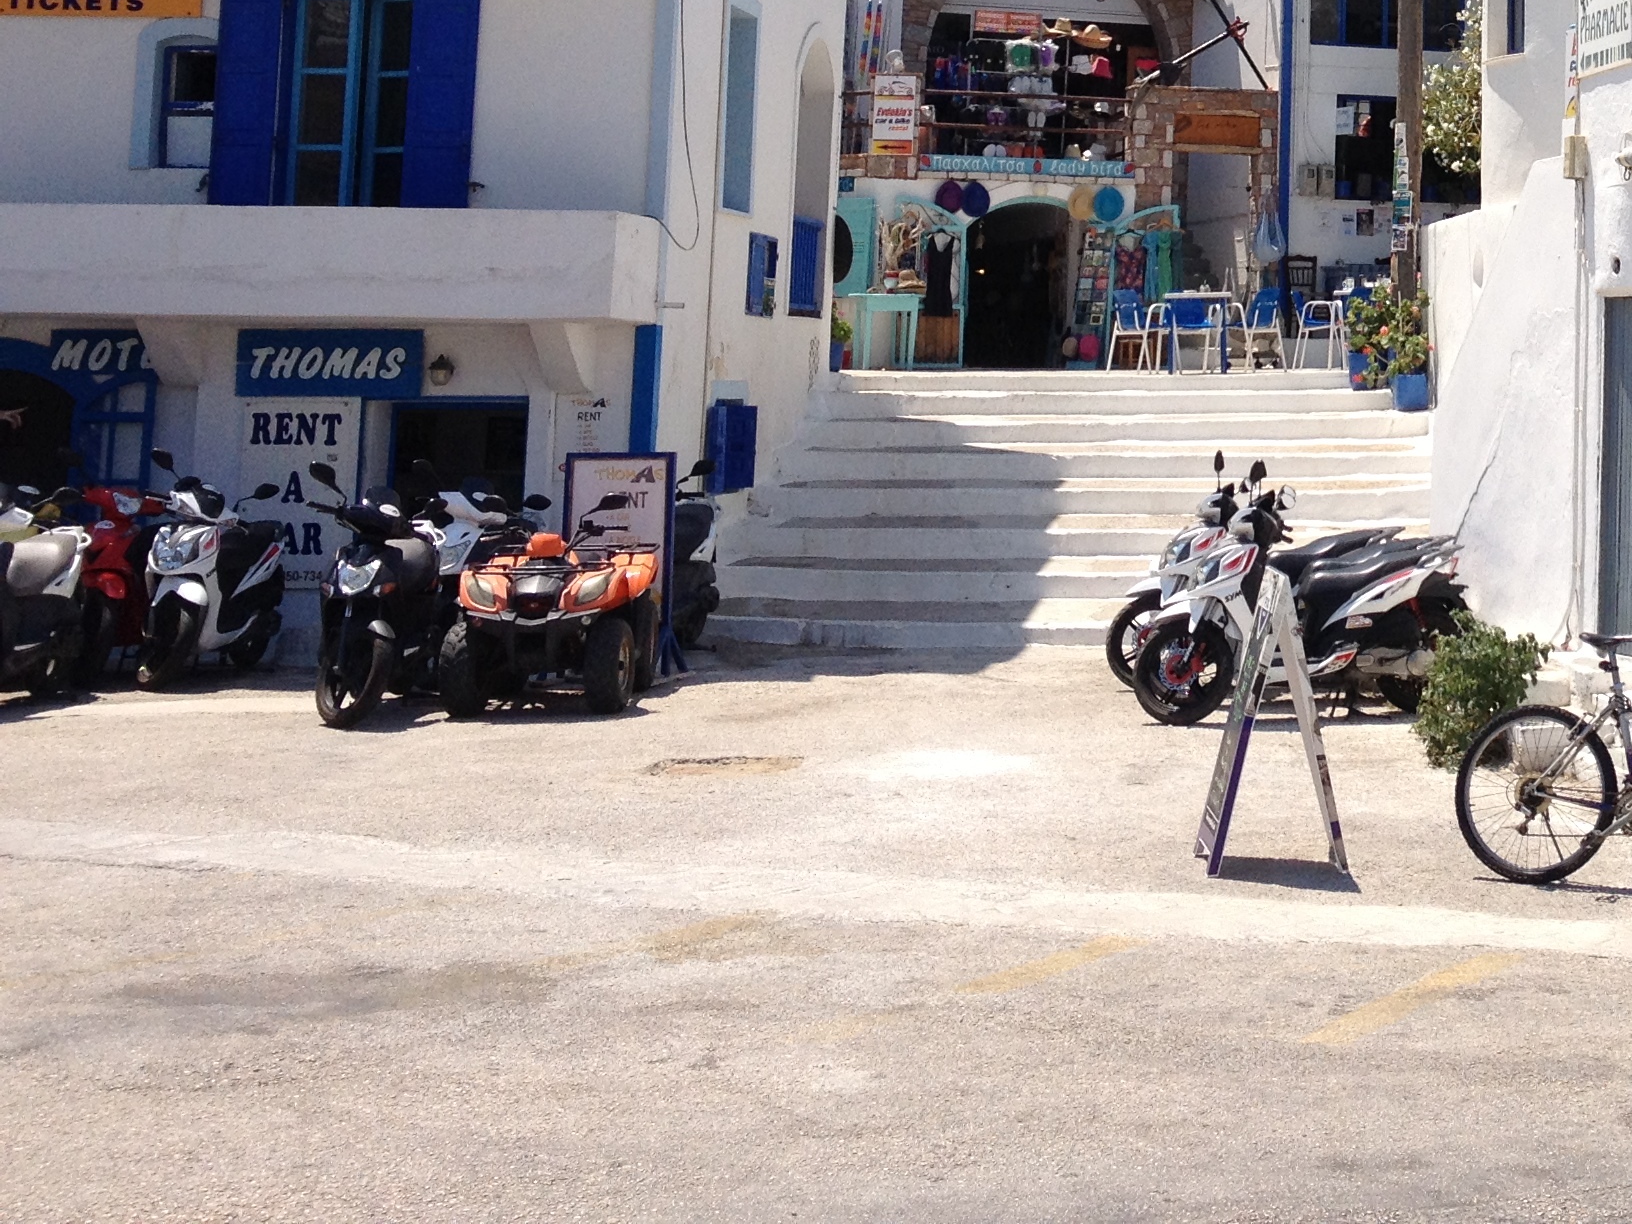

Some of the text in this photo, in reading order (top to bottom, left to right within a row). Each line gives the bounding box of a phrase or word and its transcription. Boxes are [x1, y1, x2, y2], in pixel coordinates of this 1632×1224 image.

[1580, 0, 1629, 44] PHARMACIE
[250, 346, 406, 380] THOMAS
[250, 412, 342, 446] RENT
[577, 411, 602, 422] RENT
[280, 471, 304, 504] A
[281, 522, 323, 556] AR
